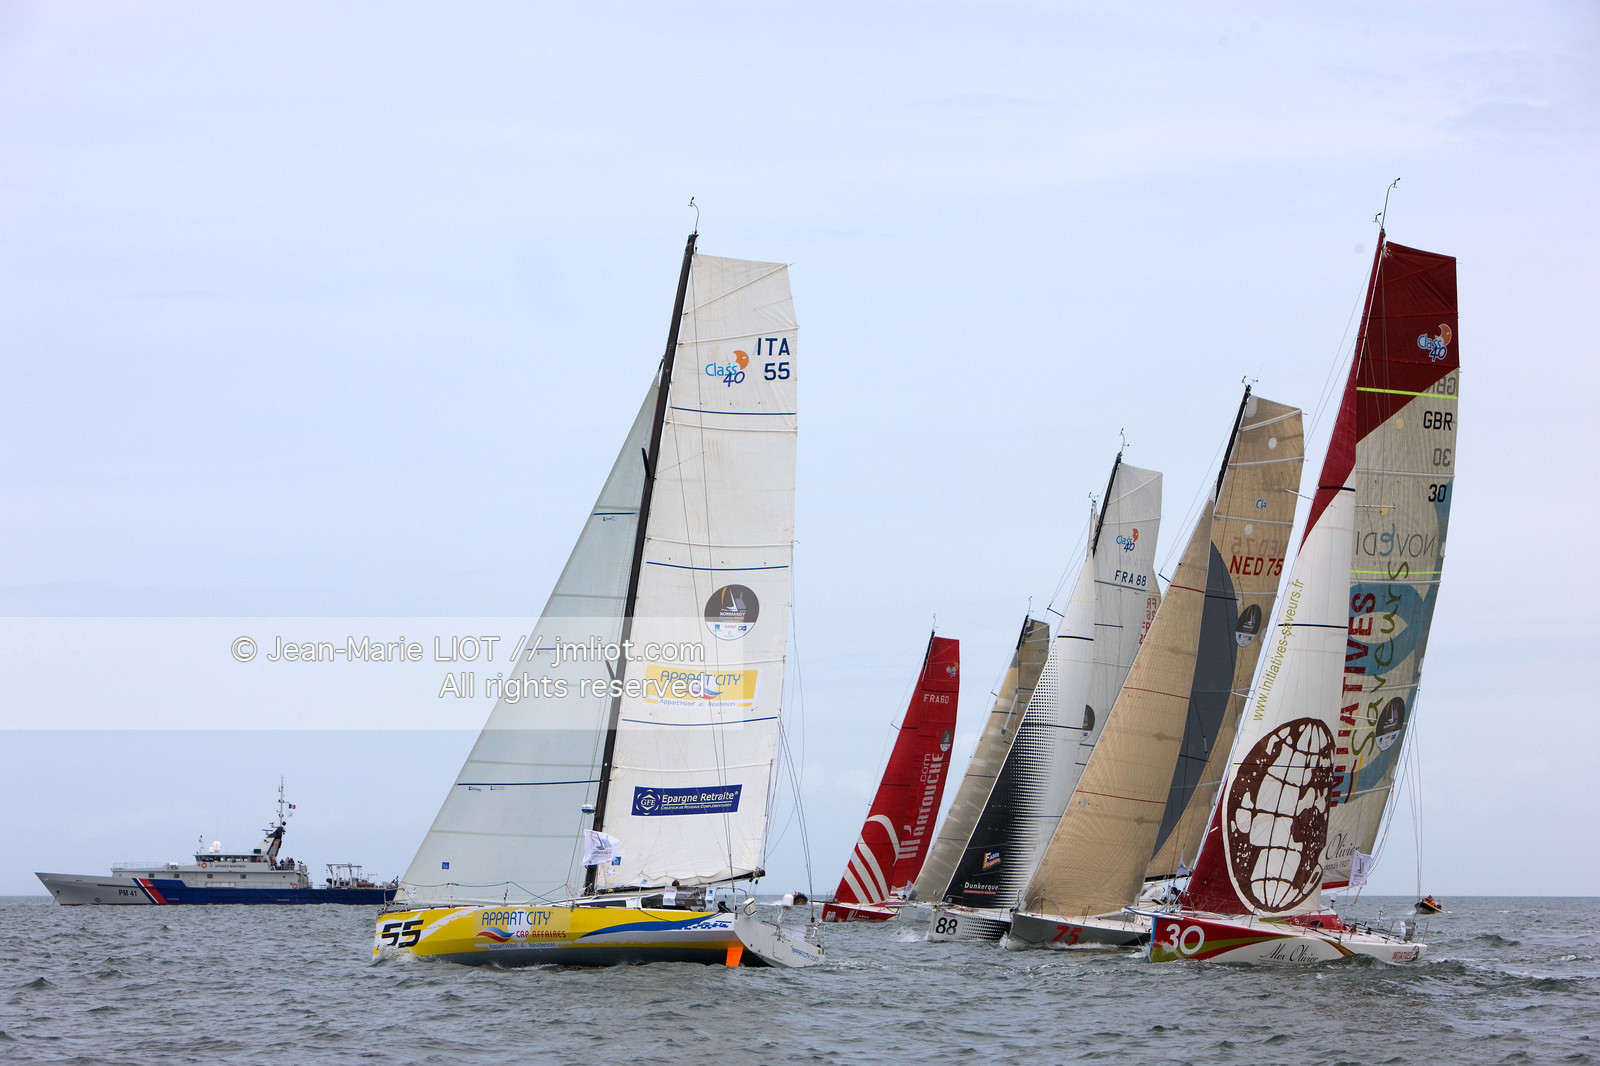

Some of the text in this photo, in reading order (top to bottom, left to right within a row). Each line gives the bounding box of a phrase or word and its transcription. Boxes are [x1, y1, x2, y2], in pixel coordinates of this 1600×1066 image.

[757, 337, 790, 356] ITA
[1417, 333, 1444, 350] Class
[1429, 346, 1448, 362] 40
[705, 363, 738, 377] Class
[723, 371, 745, 387] 40
[764, 362, 790, 381] 55
[1423, 411, 1453, 431] GBR
[1428, 484, 1447, 503] 30
[1116, 535, 1133, 545] Class
[1124, 542, 1136, 553] 40
[1229, 555, 1285, 577] NED 75
[1114, 569, 1147, 587] FRA 88
[1253, 579, 1305, 721] www.initiatives-saveurs.fr
[660, 670, 742, 687] APPAT'CITY
[661, 794, 698, 805] Epargne
[964, 881, 999, 891] Dunkerque
[381, 919, 424, 949] 55
[515, 930, 567, 938] CAP AFFAIRES
[936, 917, 958, 936] 88
[1051, 925, 1083, 945] 75
[1166, 923, 1205, 956] 30
